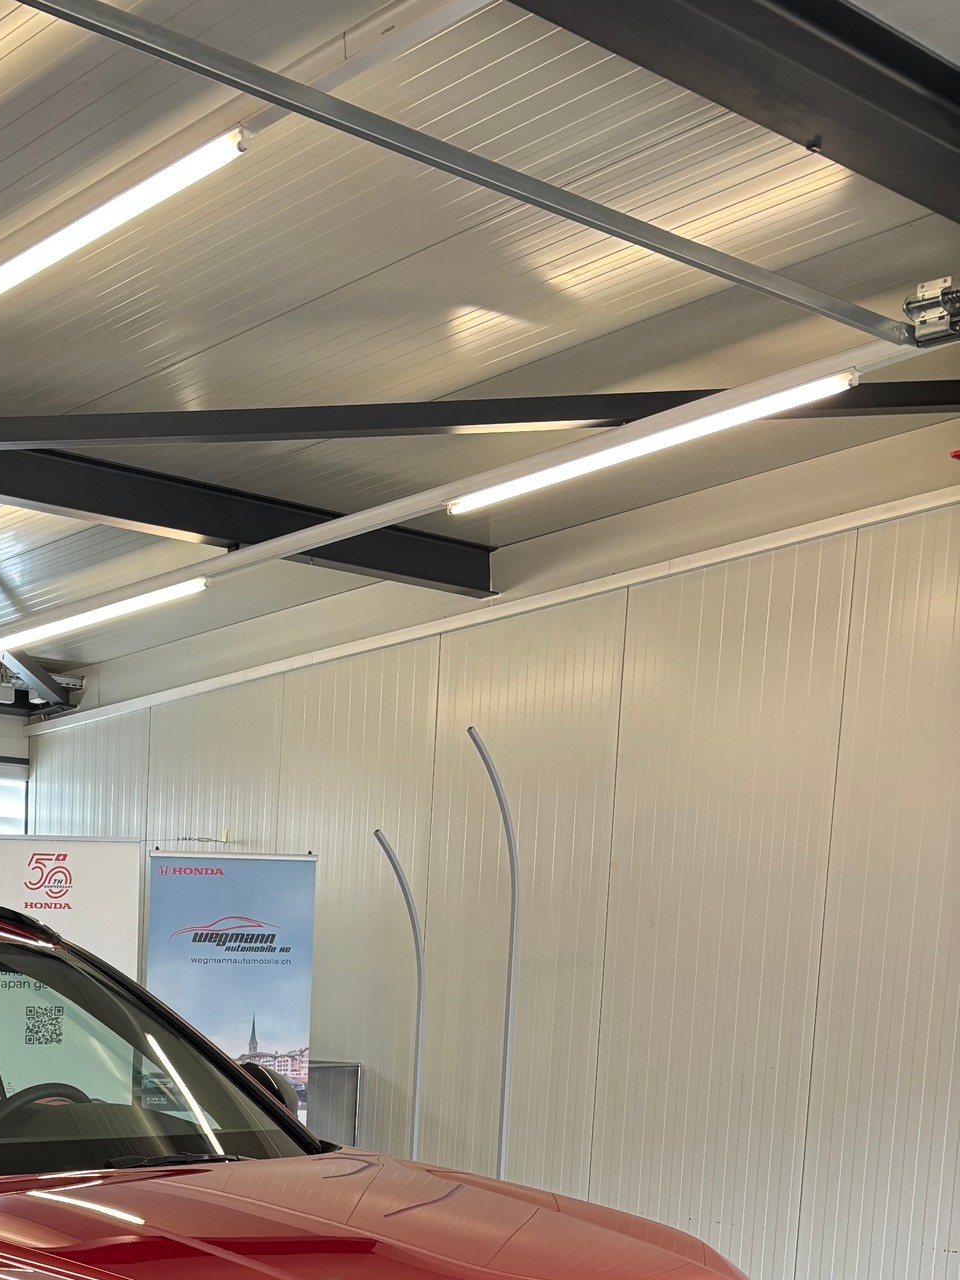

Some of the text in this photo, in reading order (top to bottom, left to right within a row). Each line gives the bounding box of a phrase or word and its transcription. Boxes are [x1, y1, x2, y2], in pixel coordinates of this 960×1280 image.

[172, 867, 224, 876] HONDA
[23, 902, 72, 910] HONDA
[192, 932, 276, 946] wegmann
[190, 957, 291, 965] wegmannautomobile.ch
